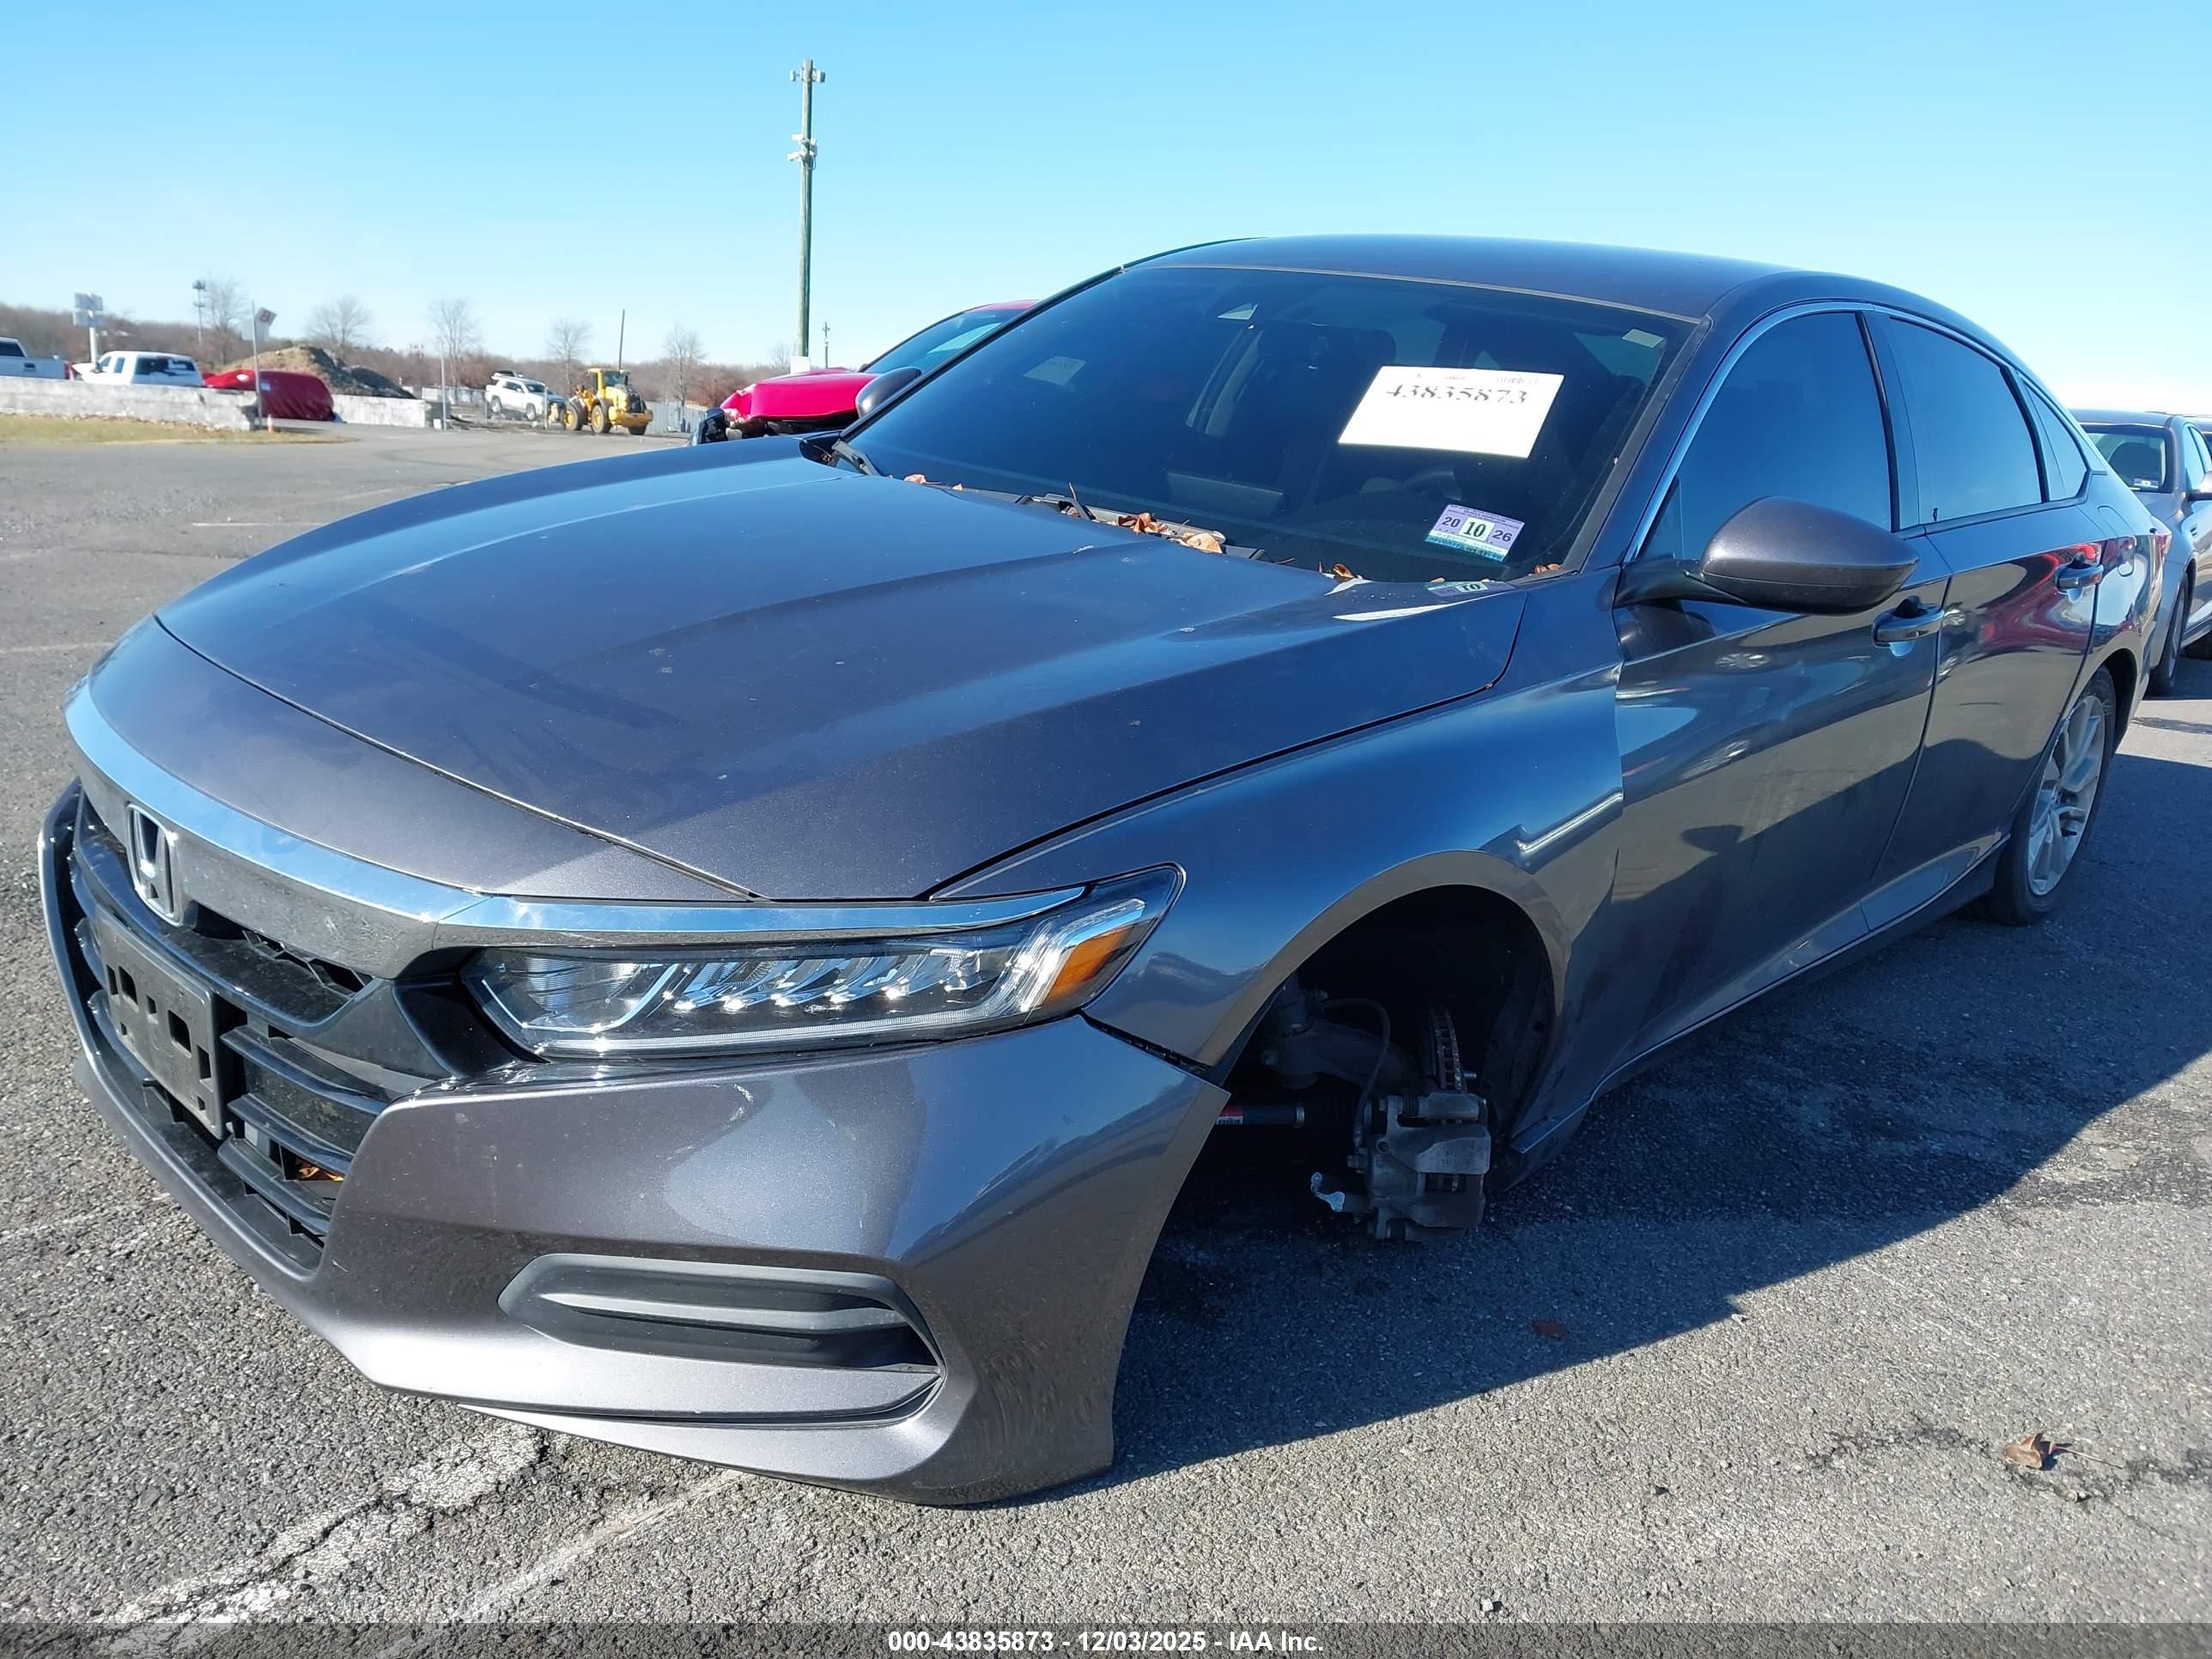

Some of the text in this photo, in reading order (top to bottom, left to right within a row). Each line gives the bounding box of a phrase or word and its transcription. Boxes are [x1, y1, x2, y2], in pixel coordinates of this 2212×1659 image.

[1386, 384, 1527, 404] 43835873
[1443, 516, 1461, 528] 20
[1463, 521, 1486, 538] 10
[1492, 530, 1512, 542] 26
